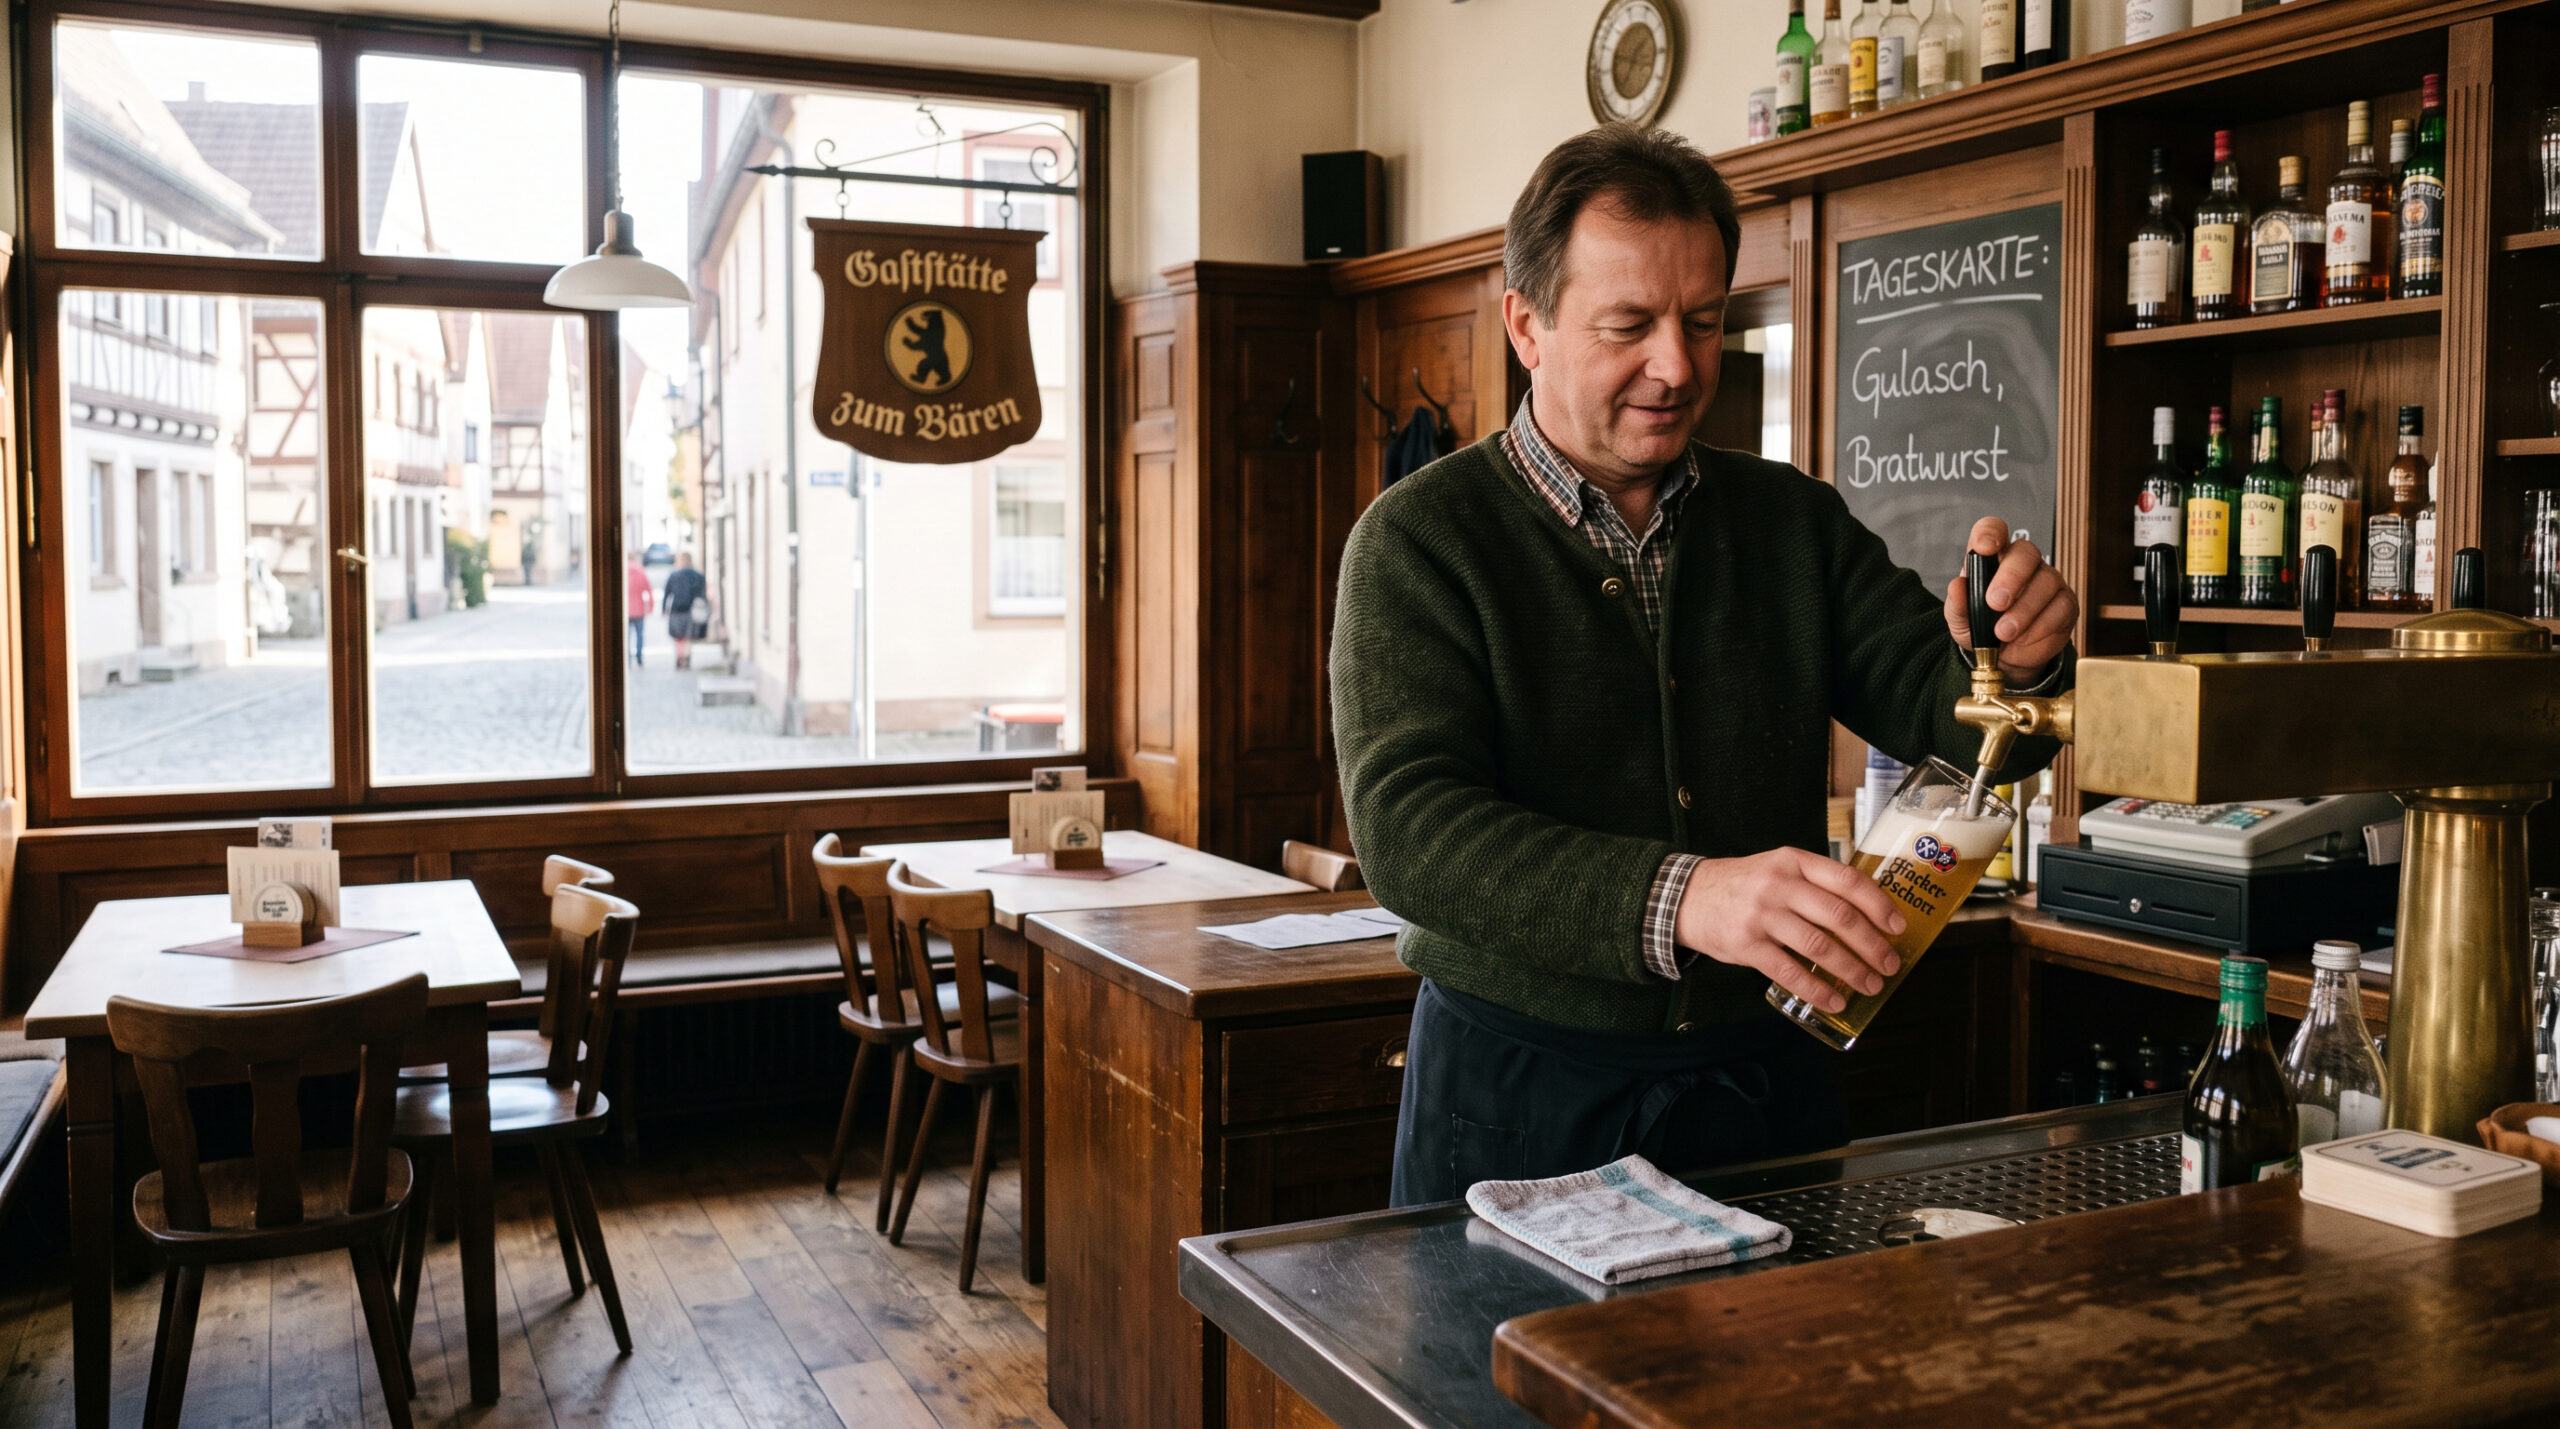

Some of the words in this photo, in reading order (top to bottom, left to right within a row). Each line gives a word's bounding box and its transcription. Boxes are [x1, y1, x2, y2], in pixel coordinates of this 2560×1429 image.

[1843, 234, 2049, 305] TAGESKARTE:
[1852, 339, 2004, 419] Gulasch,
[914, 398, 1023, 441] Bären
[1846, 424, 2009, 489] Bratwurst
[1878, 868, 1936, 916] Pschorr
